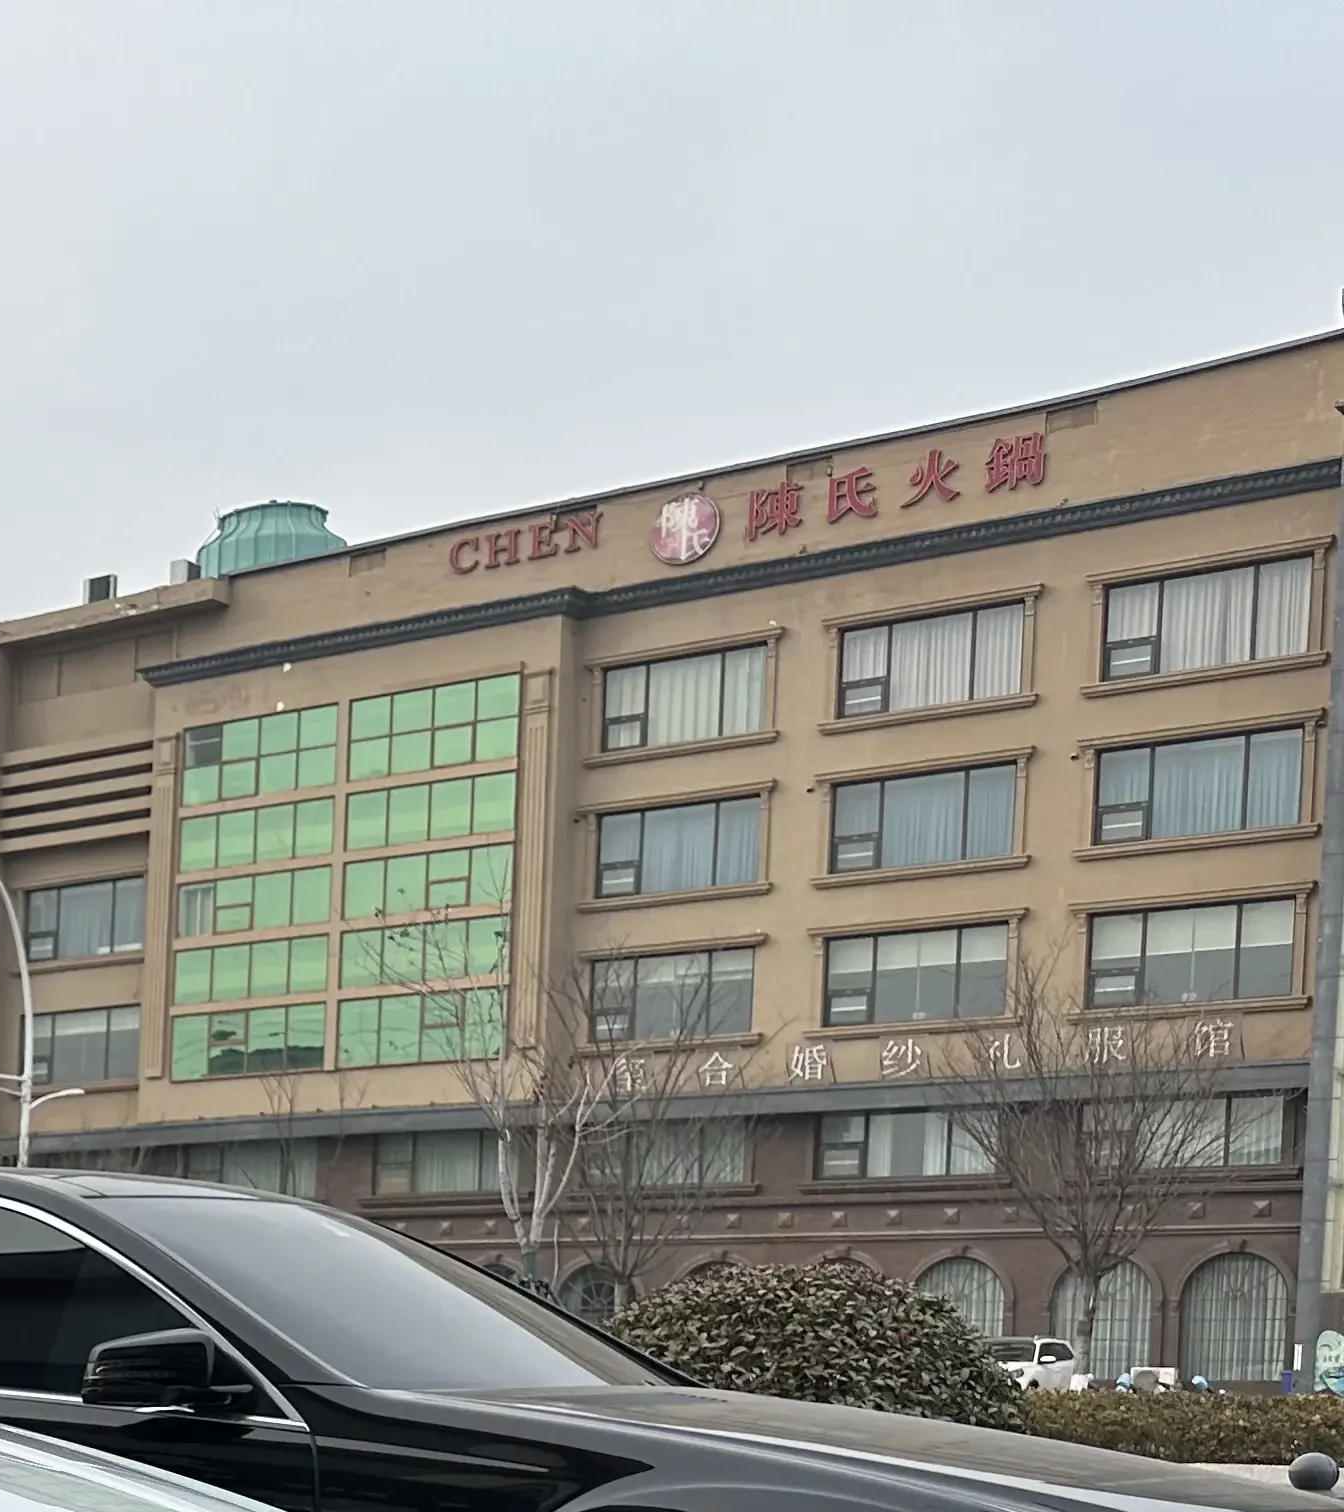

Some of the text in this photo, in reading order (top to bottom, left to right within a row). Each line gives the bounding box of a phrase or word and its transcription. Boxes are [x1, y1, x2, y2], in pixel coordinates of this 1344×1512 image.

[745, 431, 1049, 542] 陳氏火鍋
[448, 510, 604, 575] CHEN
